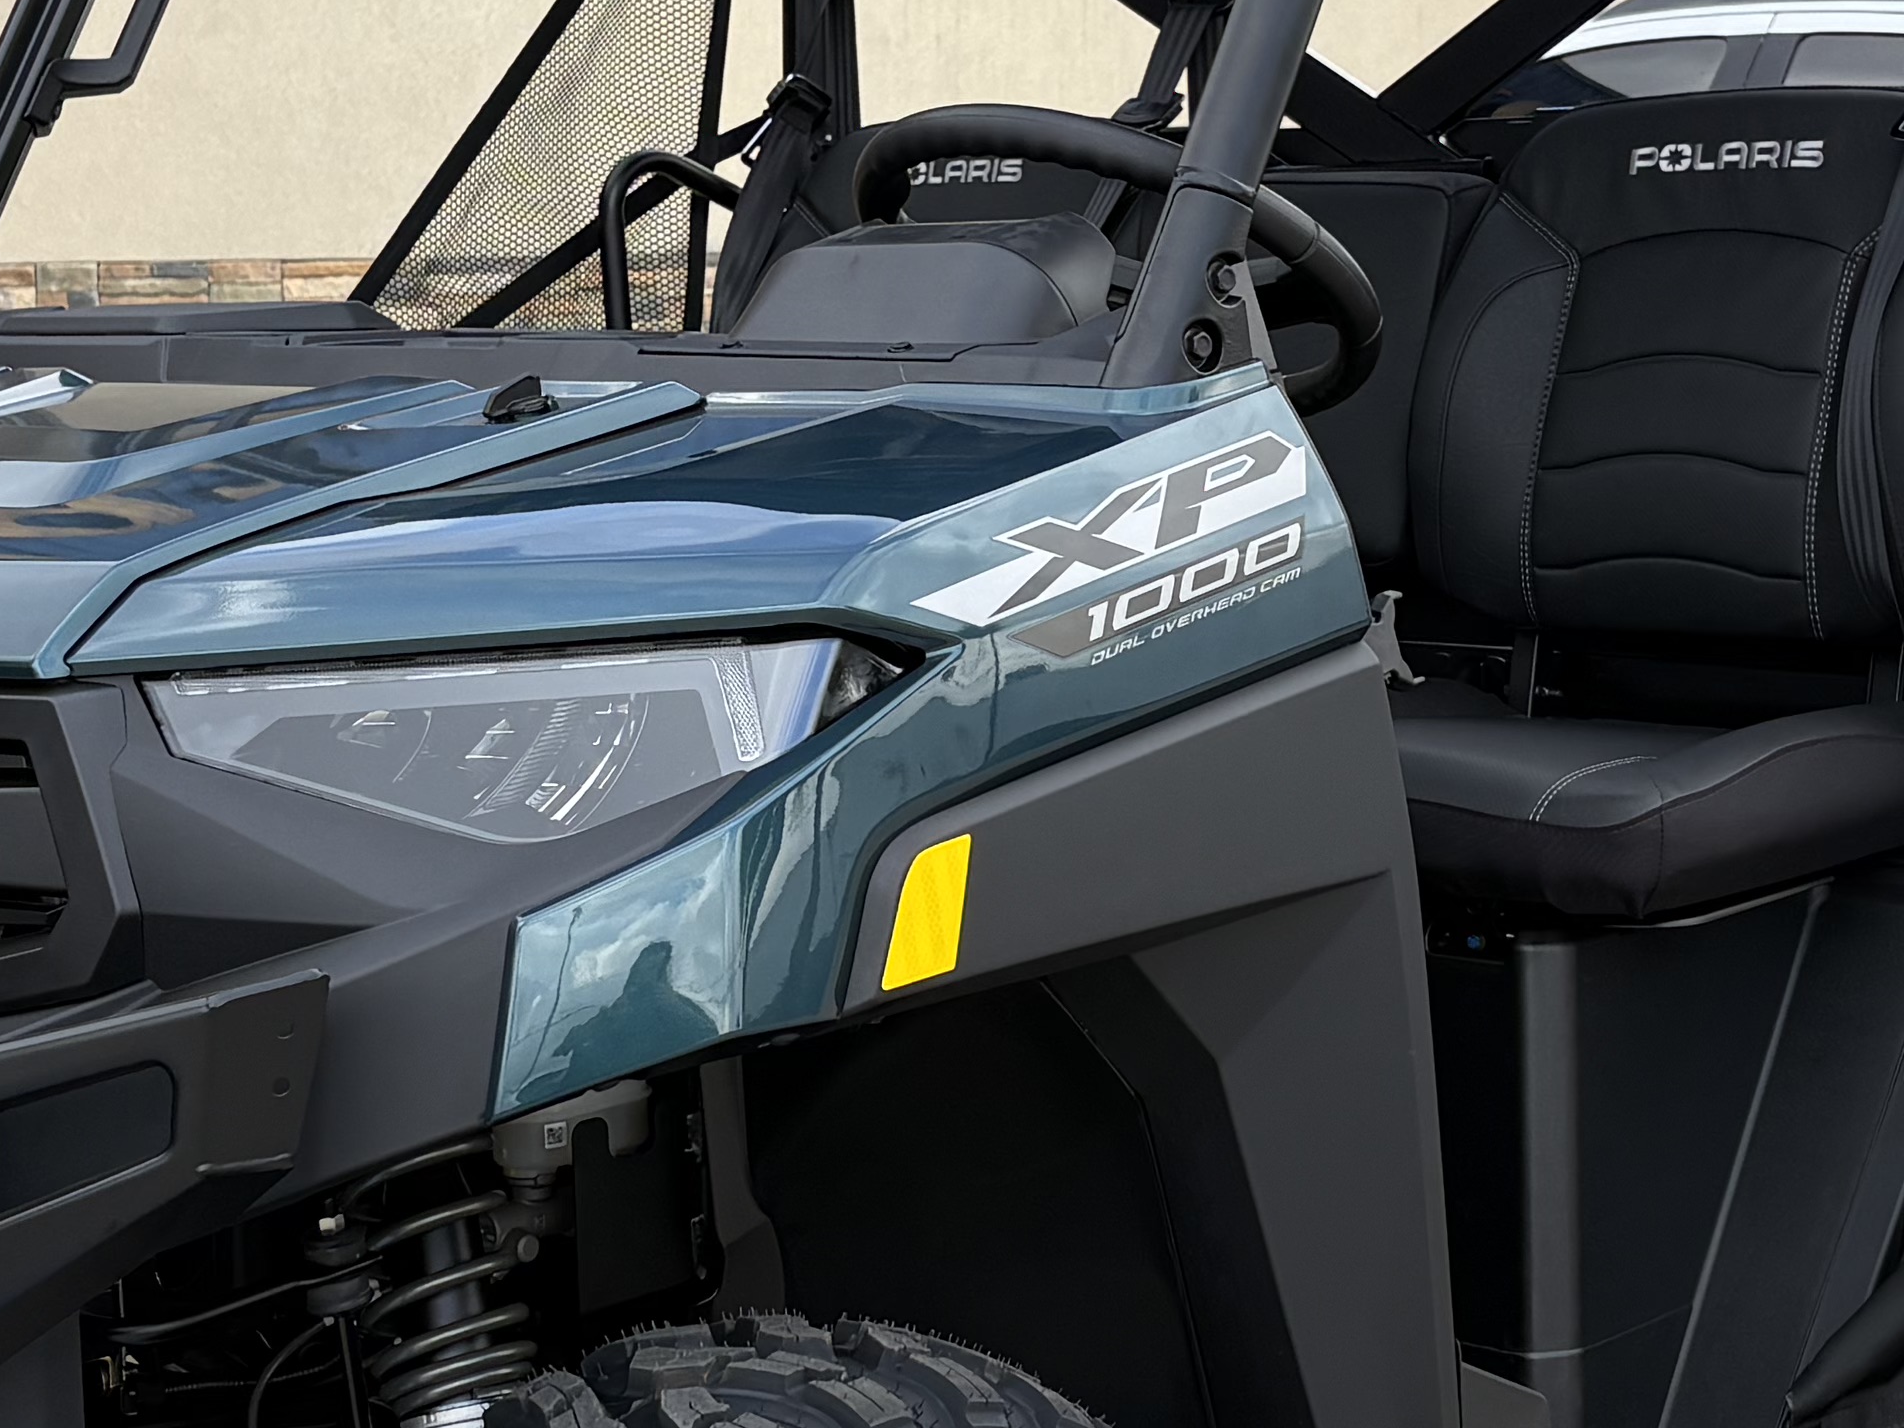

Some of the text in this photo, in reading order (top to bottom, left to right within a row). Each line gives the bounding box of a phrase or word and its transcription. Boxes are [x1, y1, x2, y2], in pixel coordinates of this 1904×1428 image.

[906, 158, 1024, 186] OLARIS
[1628, 139, 1825, 175] POLARIS
[986, 430, 1298, 624] XP
[1088, 522, 1302, 642] 1000
[1090, 566, 1302, 666] DUAL OVERHEAD CAM
